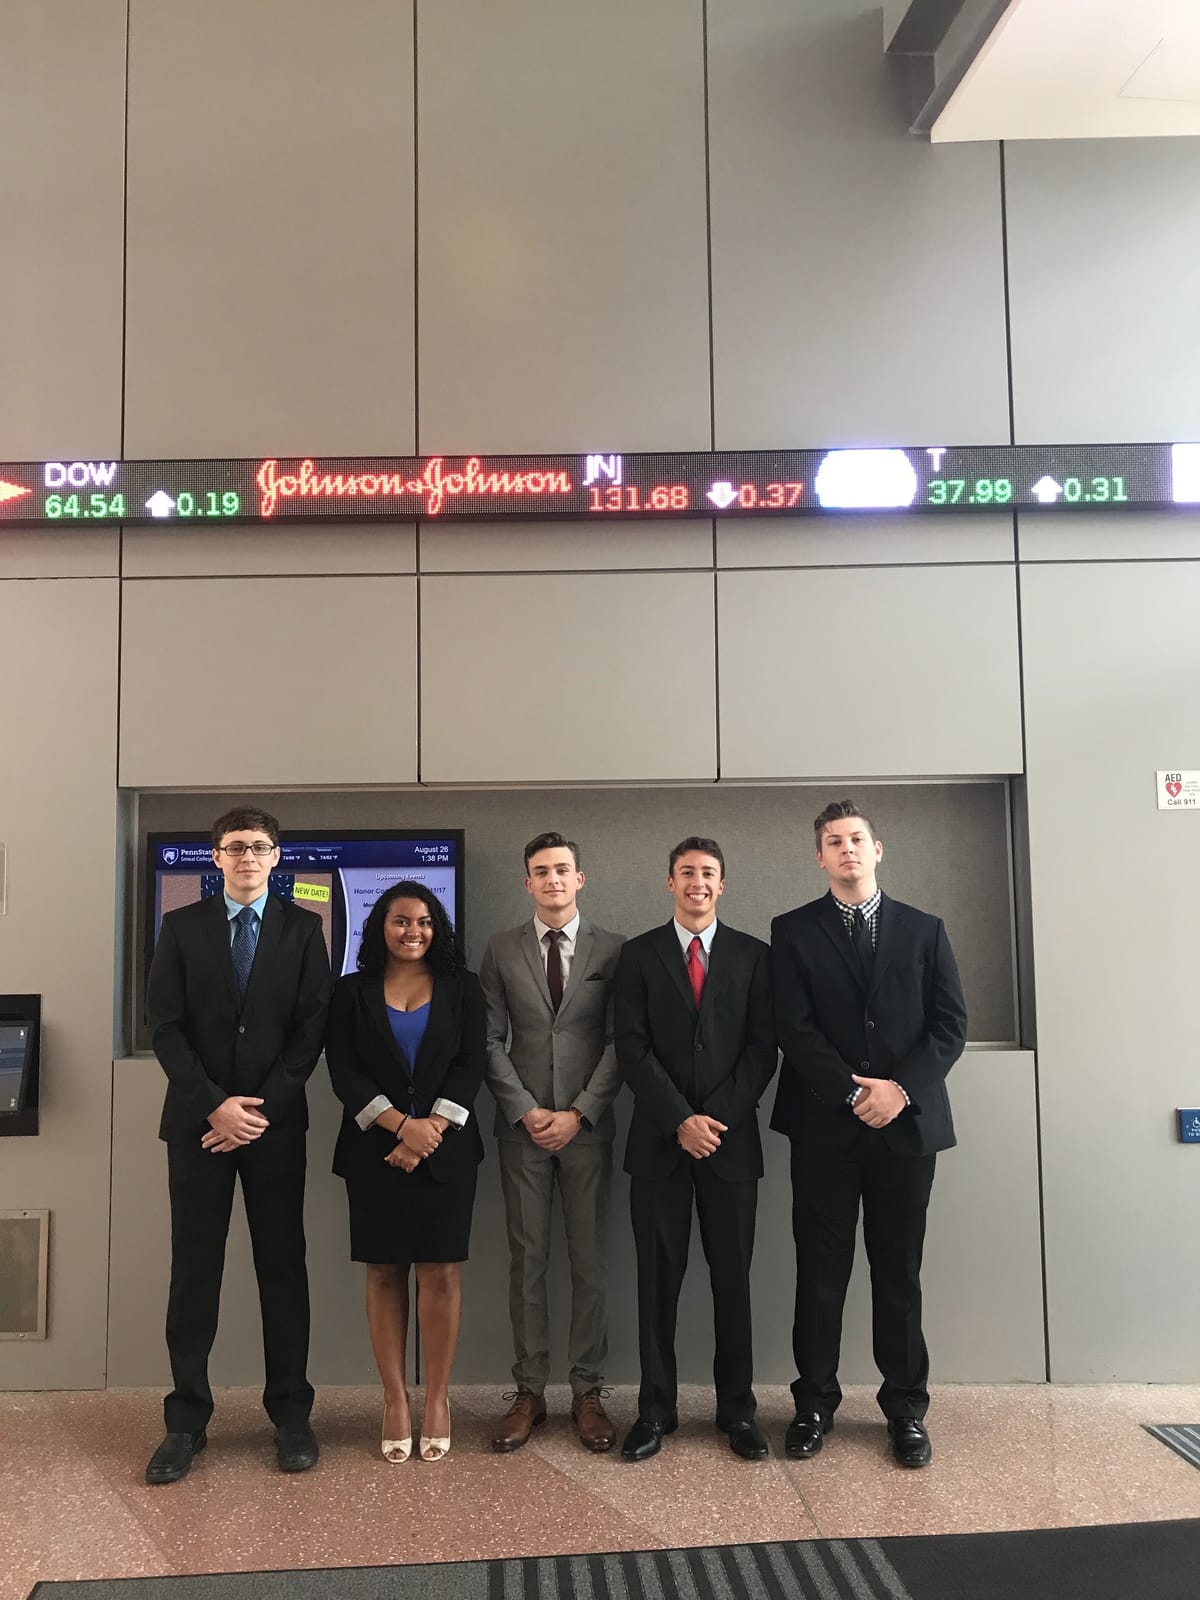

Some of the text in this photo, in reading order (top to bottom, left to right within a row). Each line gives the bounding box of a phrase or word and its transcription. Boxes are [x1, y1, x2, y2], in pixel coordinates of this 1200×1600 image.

[583, 454, 622, 486] JNJ
[926, 447, 946, 472] T
[45, 462, 117, 487] DOW
[256, 458, 404, 518] Johnson
[423, 457, 571, 515] Johnson
[588, 485, 689, 511] 131.68
[738, 482, 804, 509] 0.37
[927, 479, 1013, 505] 37.99
[1062, 476, 1128, 503] 0.31
[44, 493, 126, 519] 64.54
[176, 492, 240, 517] 0.19
[1165, 773, 1182, 782] AED
[414, 846, 439, 855] August
[375, 873, 406, 881] Upcoming
[294, 887, 311, 896] NEW
